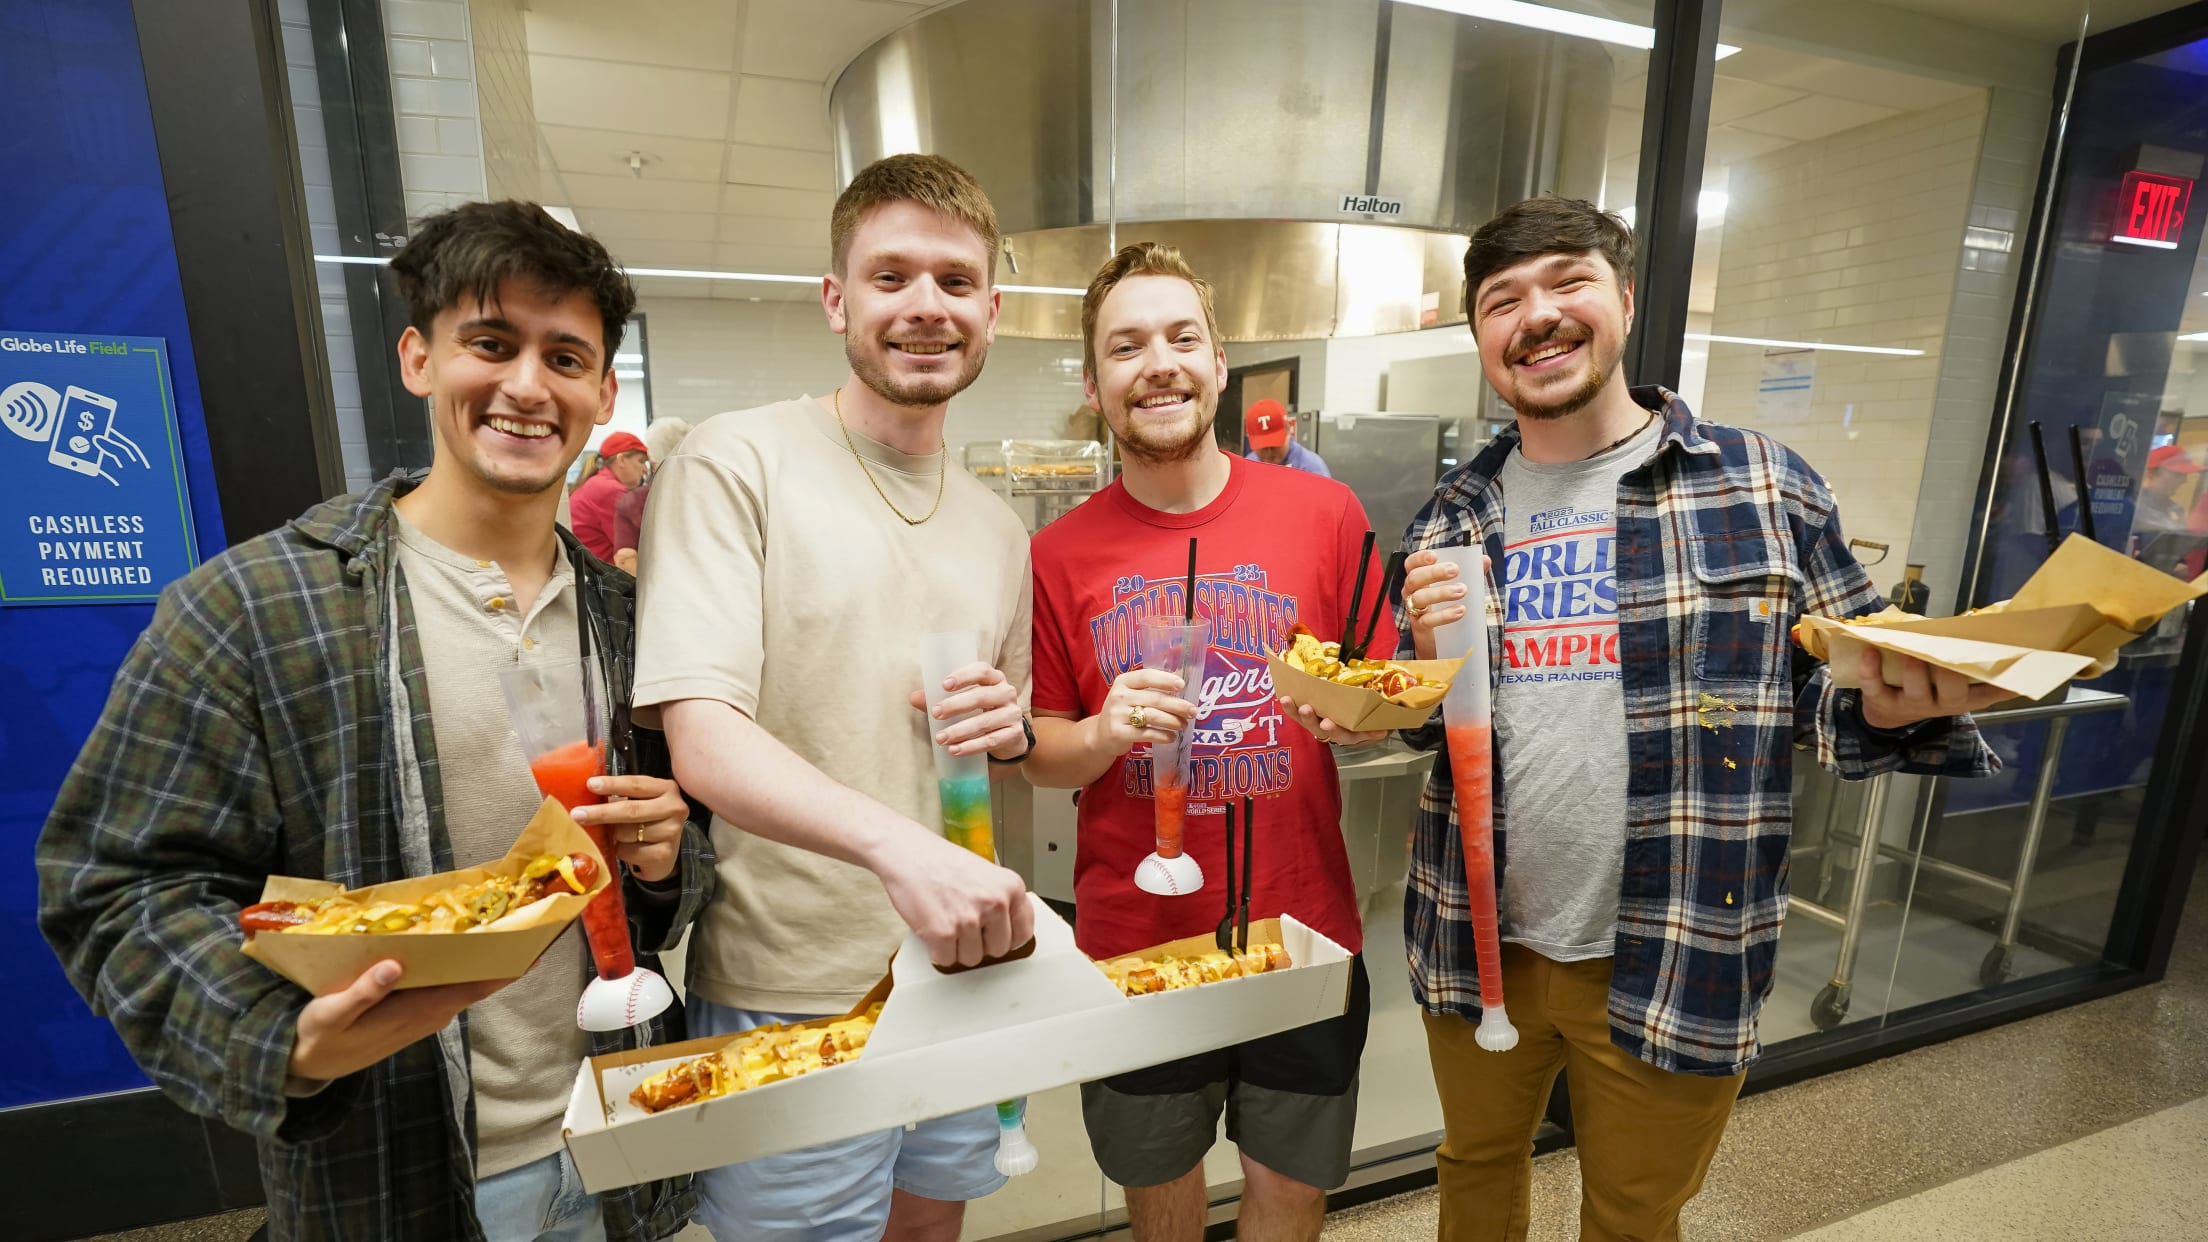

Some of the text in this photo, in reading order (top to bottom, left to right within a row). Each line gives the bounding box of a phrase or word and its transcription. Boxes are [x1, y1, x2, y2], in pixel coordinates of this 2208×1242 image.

[1343, 196, 1401, 215] Halton
[2127, 181, 2181, 241] EXIT
[1, 338, 128, 355] Globe Life Field
[1257, 415, 1271, 430] T
[29, 515, 145, 534] CASHLESS
[1530, 512, 1609, 533] FALL CLASSIC
[39, 541, 144, 560] PAYMENT
[41, 566, 151, 586] REQUIRED
[1117, 564, 1261, 593] 20 23
[1506, 575, 1618, 622] RIES
[1194, 579, 1297, 656] SERIES
[1500, 673, 1544, 684] TEXAS
[1193, 731, 1237, 743] XAS
[1124, 748, 1292, 799] CHMPIONS
